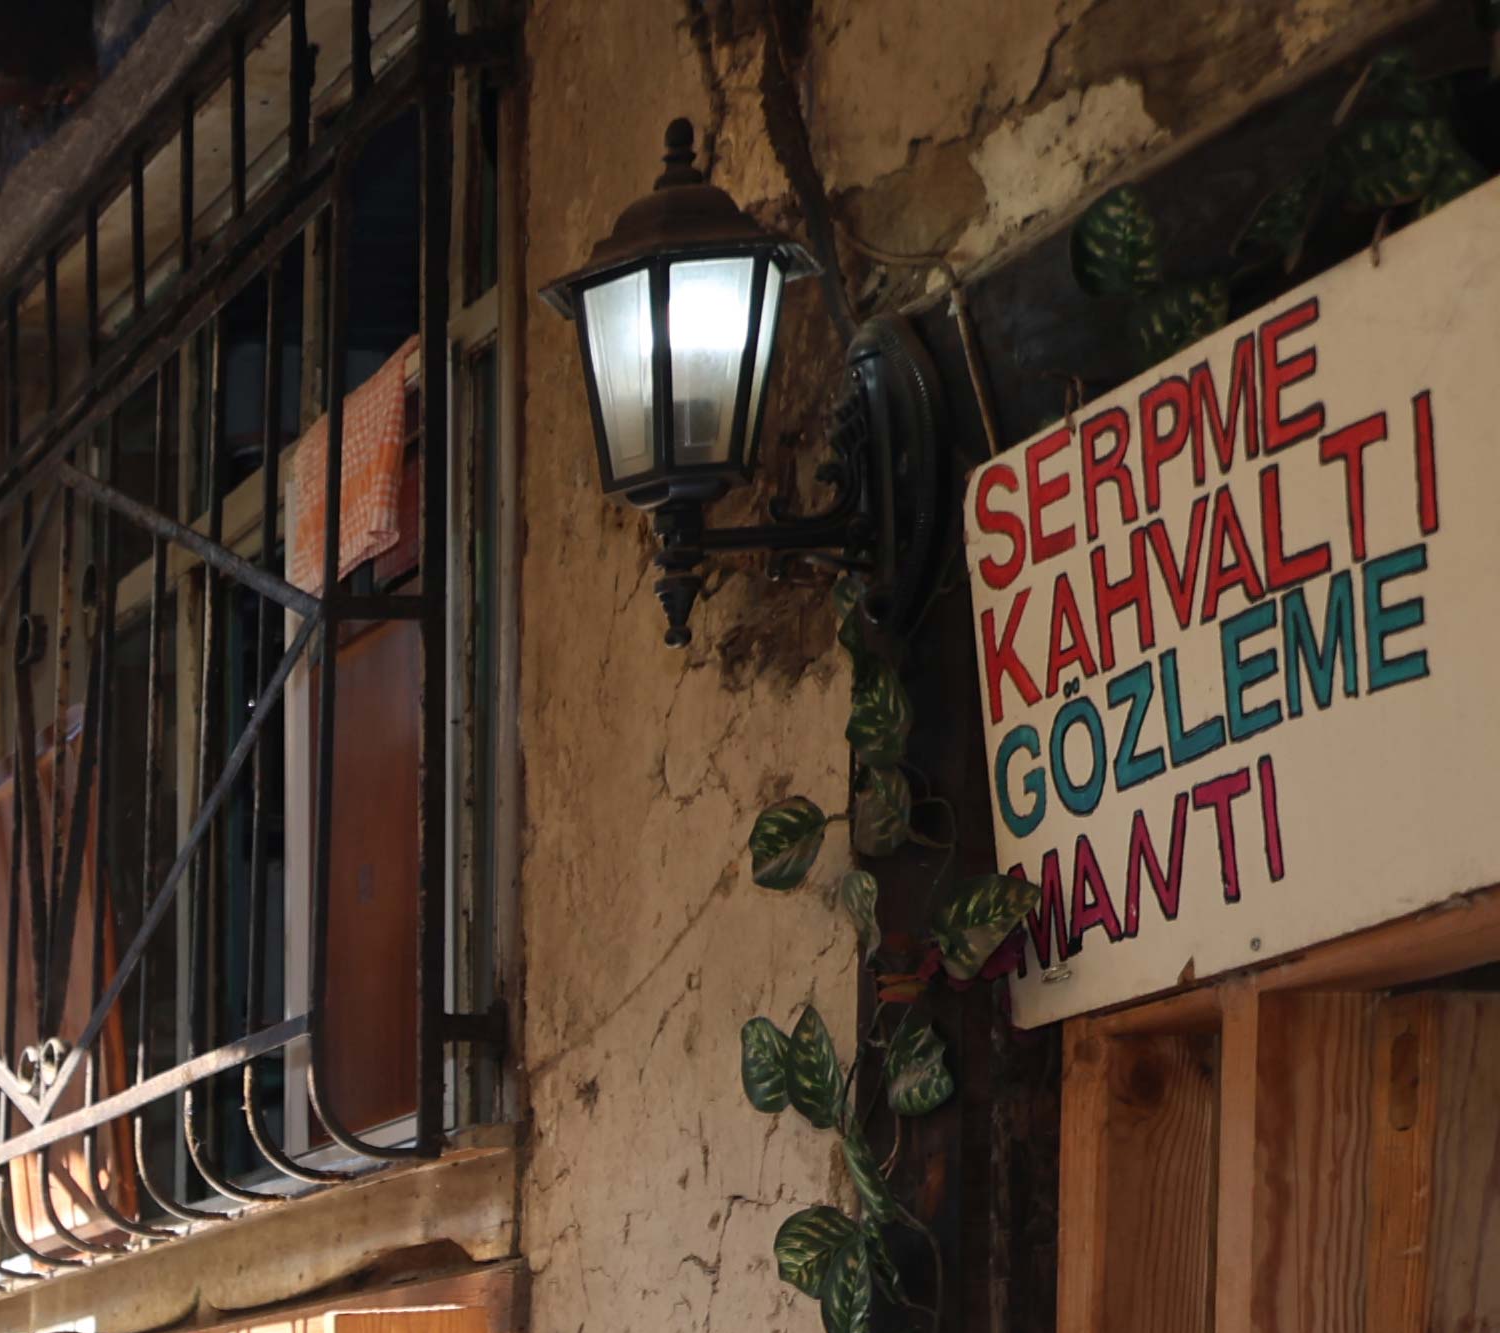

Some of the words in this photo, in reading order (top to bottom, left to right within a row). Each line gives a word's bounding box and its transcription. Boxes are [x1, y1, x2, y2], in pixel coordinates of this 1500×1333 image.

[975, 297, 1324, 589] SERPME
[982, 390, 1439, 725] KAHVALTI
[995, 545, 1431, 838] GÖZLEME
[1008, 756, 1285, 978] MANTI
